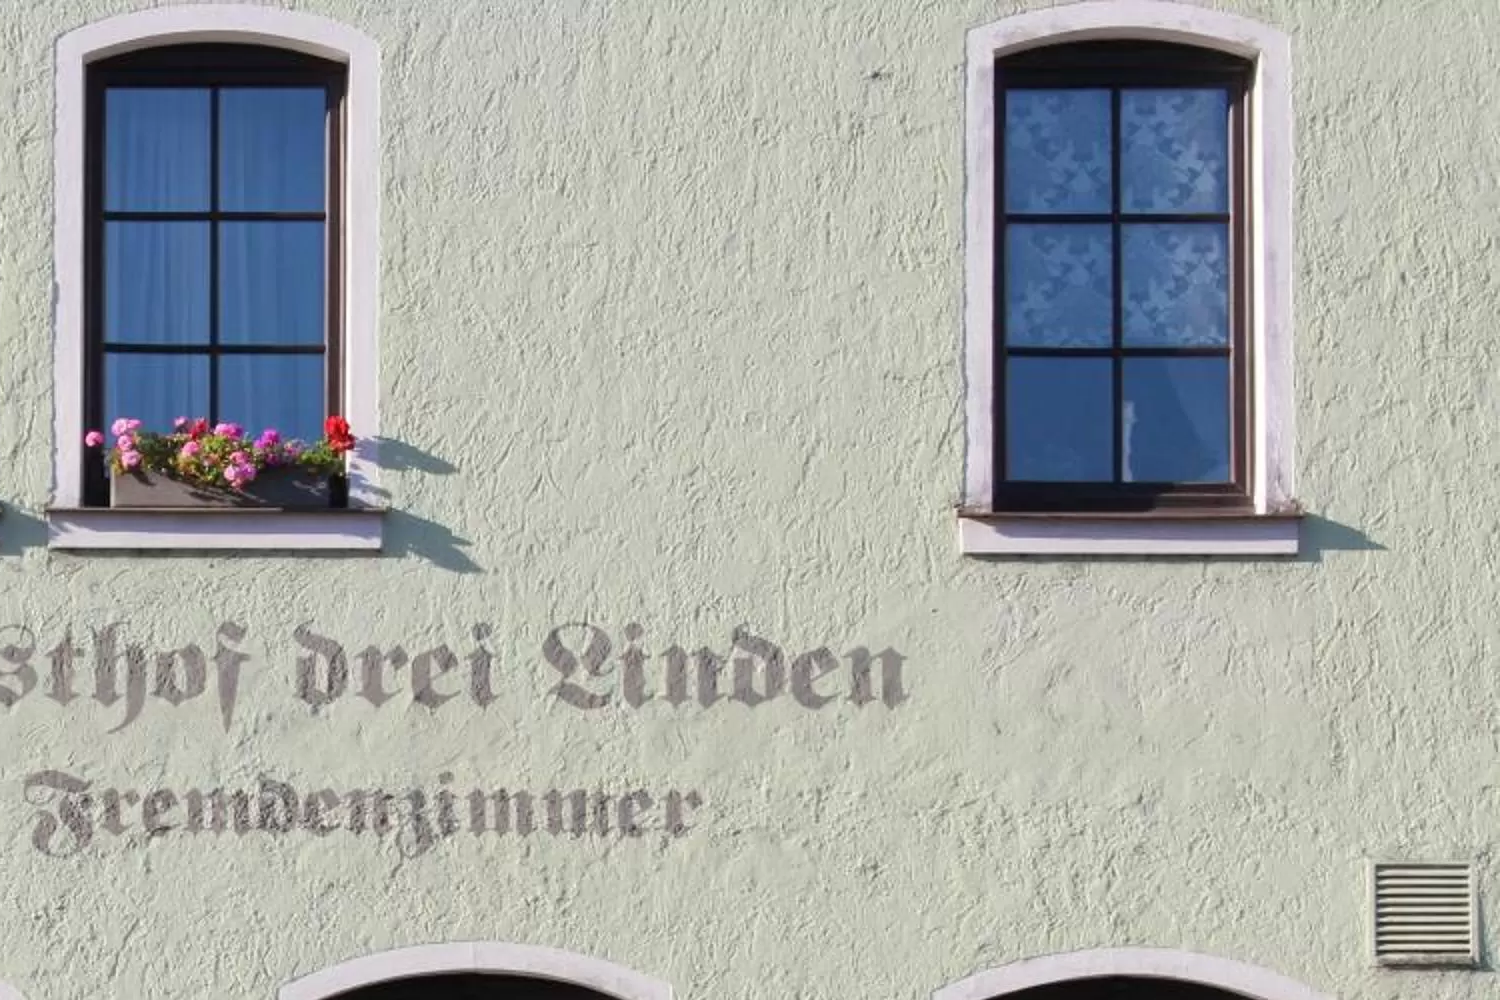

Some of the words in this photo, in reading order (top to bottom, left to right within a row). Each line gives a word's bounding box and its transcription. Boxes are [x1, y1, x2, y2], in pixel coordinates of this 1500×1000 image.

[294, 622, 501, 708] drei
[542, 622, 909, 709] Linden
[23, 769, 703, 858] Fremdenzimmer
